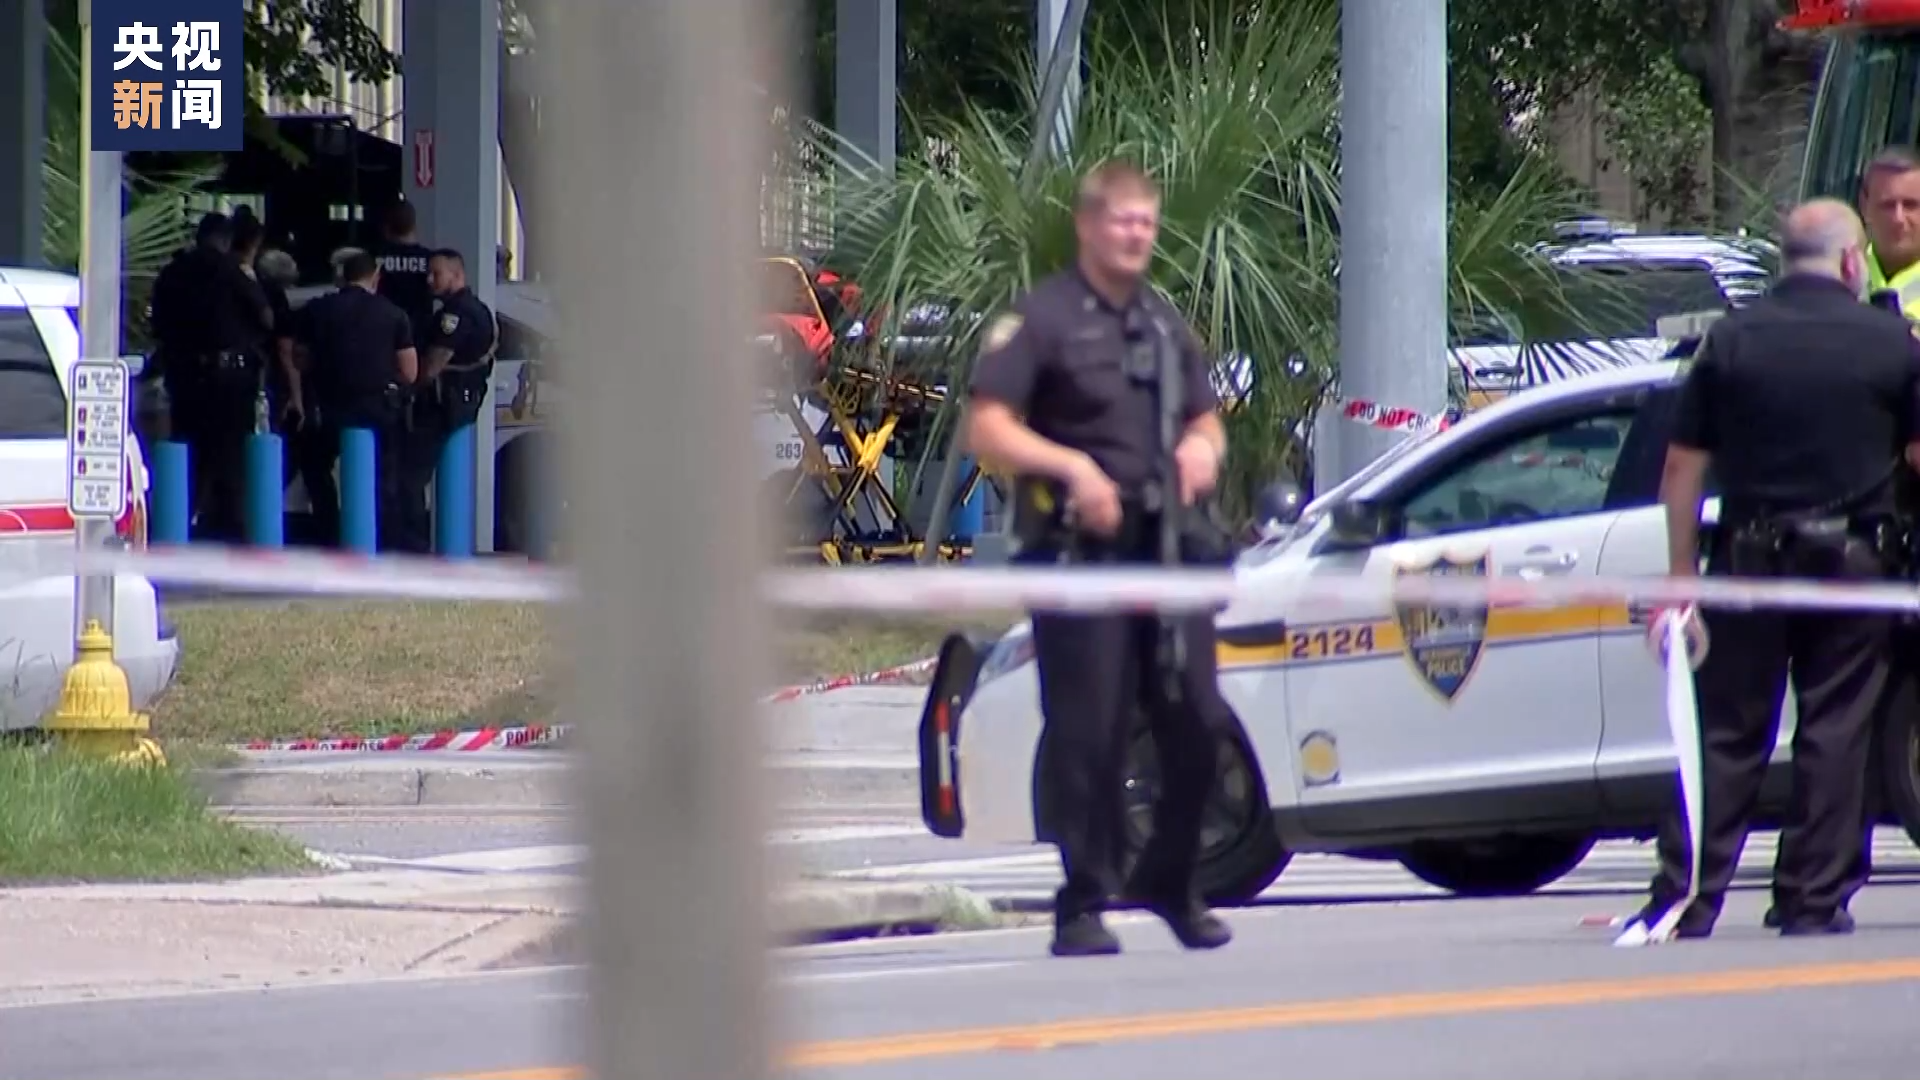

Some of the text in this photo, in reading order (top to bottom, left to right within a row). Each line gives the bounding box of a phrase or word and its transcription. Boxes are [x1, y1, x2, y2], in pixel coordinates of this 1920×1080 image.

[375, 256, 427, 272] POLICE
[1359, 401, 1376, 420] DO
[1378, 406, 1405, 426] NOT
[1291, 625, 1374, 660] 2124
[505, 727, 552, 747] POLICE
